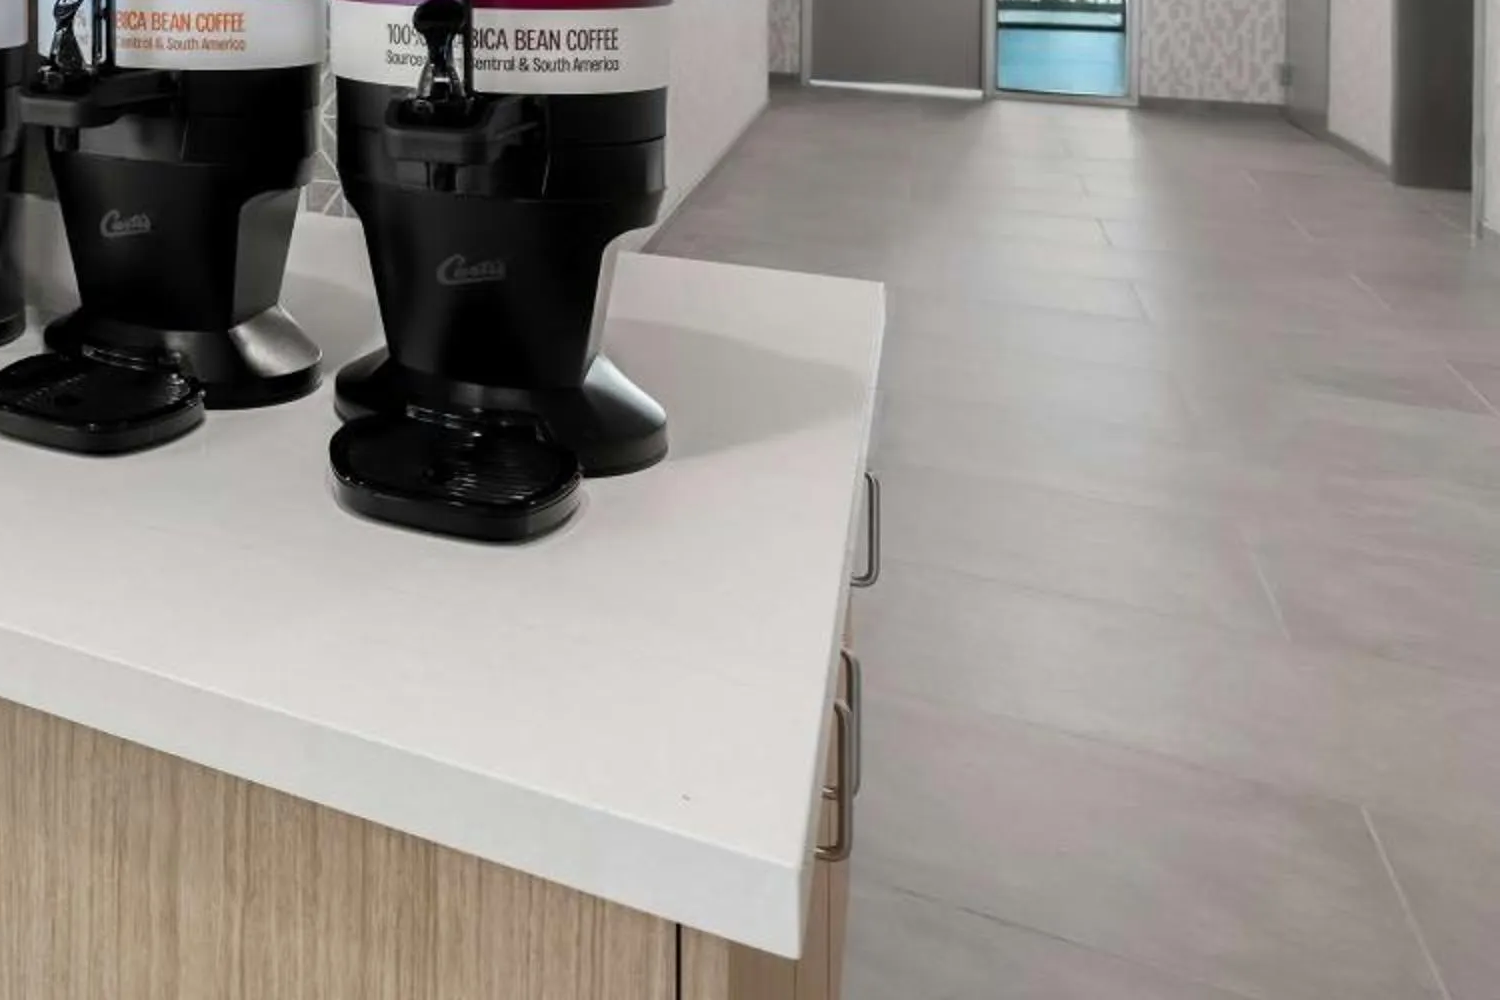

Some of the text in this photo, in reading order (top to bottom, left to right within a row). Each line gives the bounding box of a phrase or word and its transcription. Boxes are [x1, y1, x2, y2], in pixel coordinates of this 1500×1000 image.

[151, 12, 192, 32] BEAN
[195, 13, 245, 33] COFFEE
[457, 27, 509, 51] BICA
[515, 29, 561, 51] BEAN
[566, 28, 619, 51] COFFEE
[472, 55, 515, 72] entral
[519, 57, 529, 72] &
[533, 56, 571, 73] South
[573, 56, 620, 72] America
